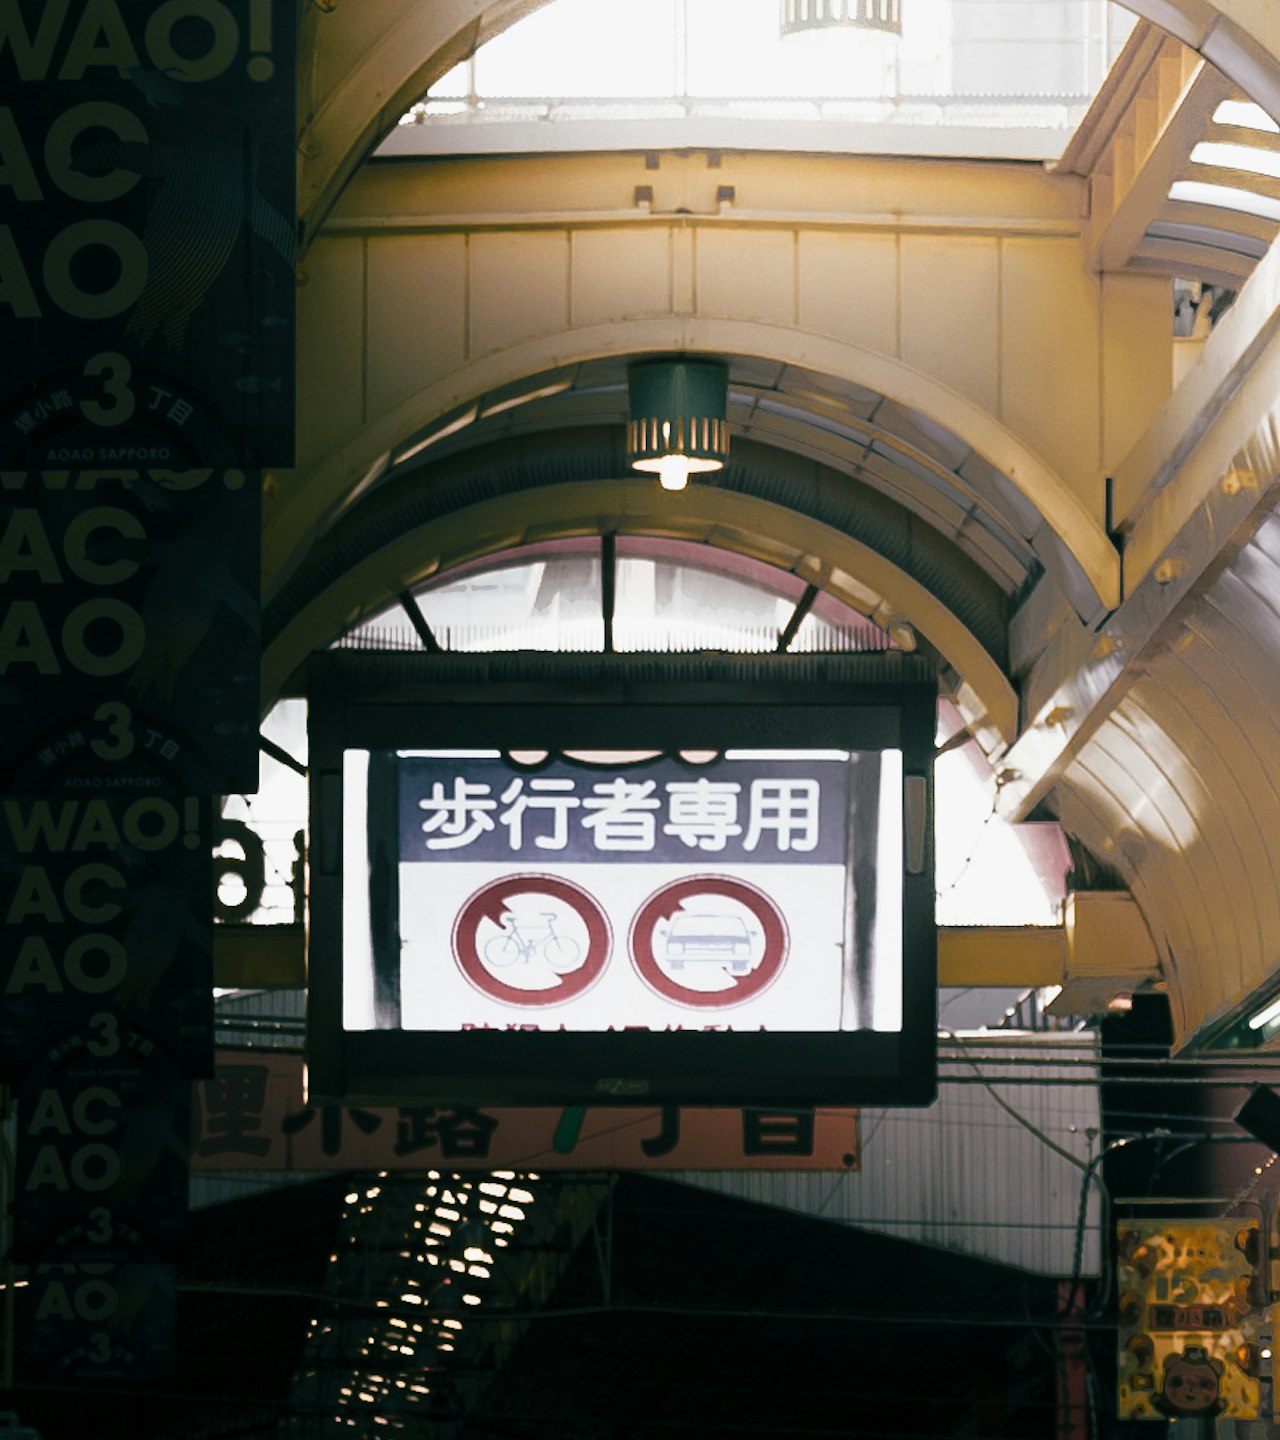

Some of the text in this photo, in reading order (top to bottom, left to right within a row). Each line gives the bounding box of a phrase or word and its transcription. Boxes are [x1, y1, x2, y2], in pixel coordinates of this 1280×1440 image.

[99, 447, 171, 461] SAPPORO
[3, 797, 200, 853] WAO!
[419, 776, 821, 852] 歩行者専用
[5, 863, 127, 924] AC
[5, 932, 128, 994] AO
[27, 1087, 122, 1137] AC
[25, 1143, 120, 1192] AO
[35, 1279, 119, 1321] AO
